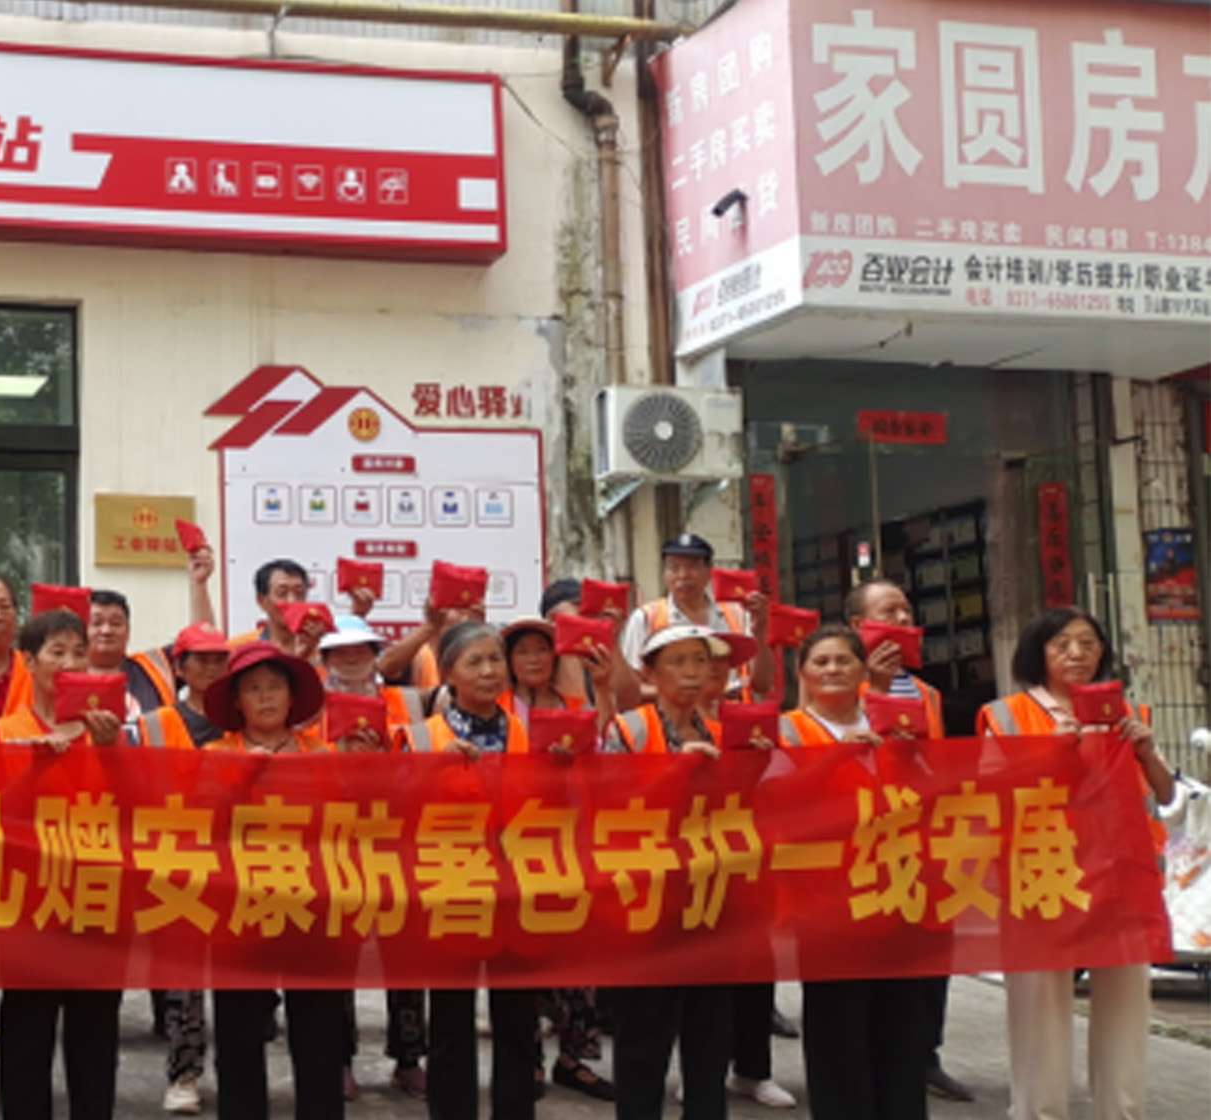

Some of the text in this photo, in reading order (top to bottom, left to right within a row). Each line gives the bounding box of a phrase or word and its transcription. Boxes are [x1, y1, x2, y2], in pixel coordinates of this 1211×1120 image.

[811, 9, 1211, 203] 家圆房
[671, 100, 776, 190] 二手房买卖
[810, 210, 896, 237] 新房团购
[915, 216, 1022, 244] 二手房买卖
[860, 252, 954, 286] 百业会计
[964, 253, 1211, 292] 会计培训/学历提升/职业证
